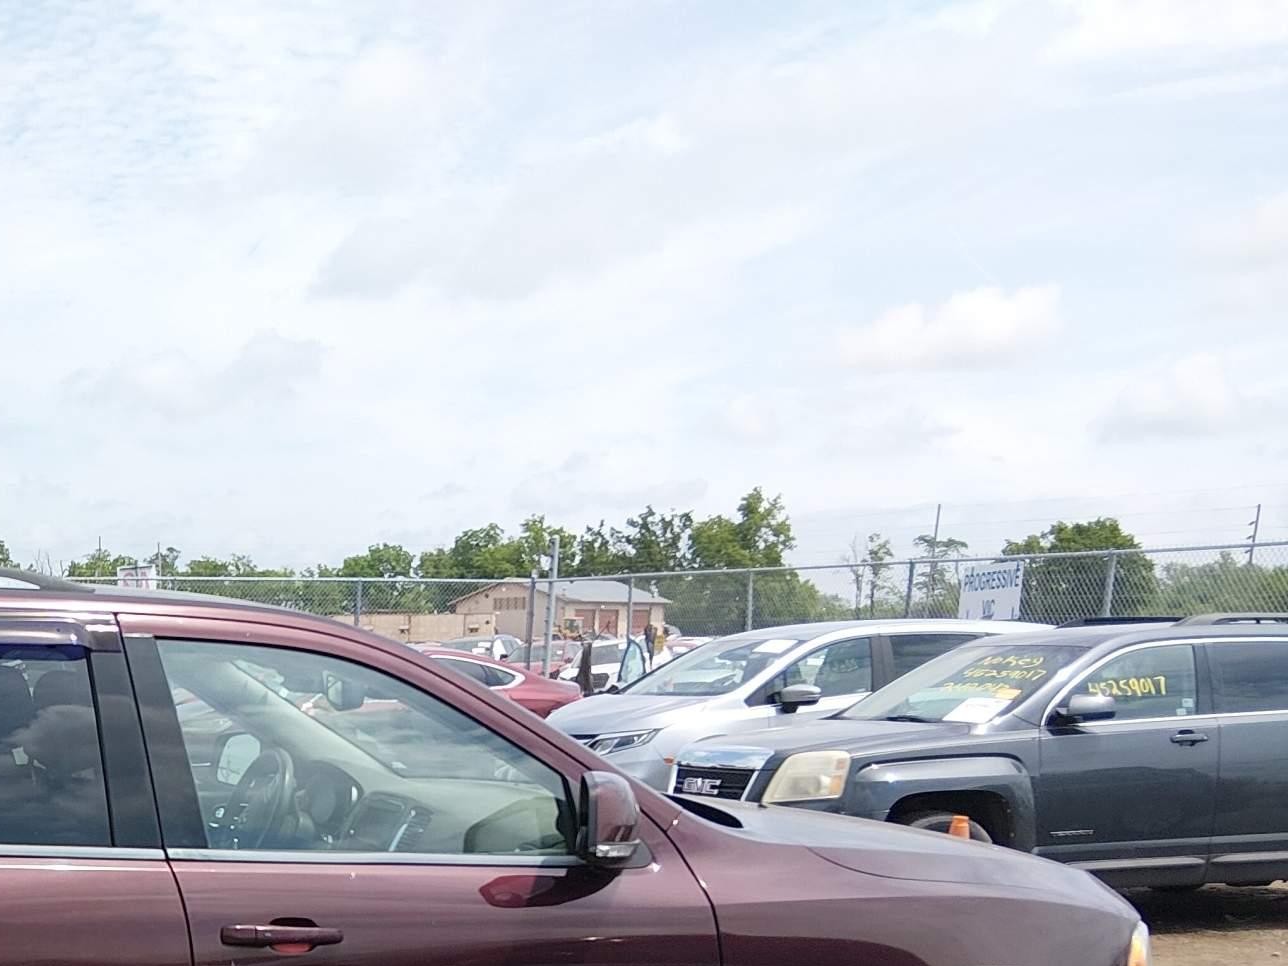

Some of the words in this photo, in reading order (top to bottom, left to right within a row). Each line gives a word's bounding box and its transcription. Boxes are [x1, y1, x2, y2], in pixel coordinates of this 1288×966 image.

[964, 567, 1021, 592] PROGRESSIVE
[1088, 675, 1167, 697] 45259017
[682, 777, 722, 795] GMC
